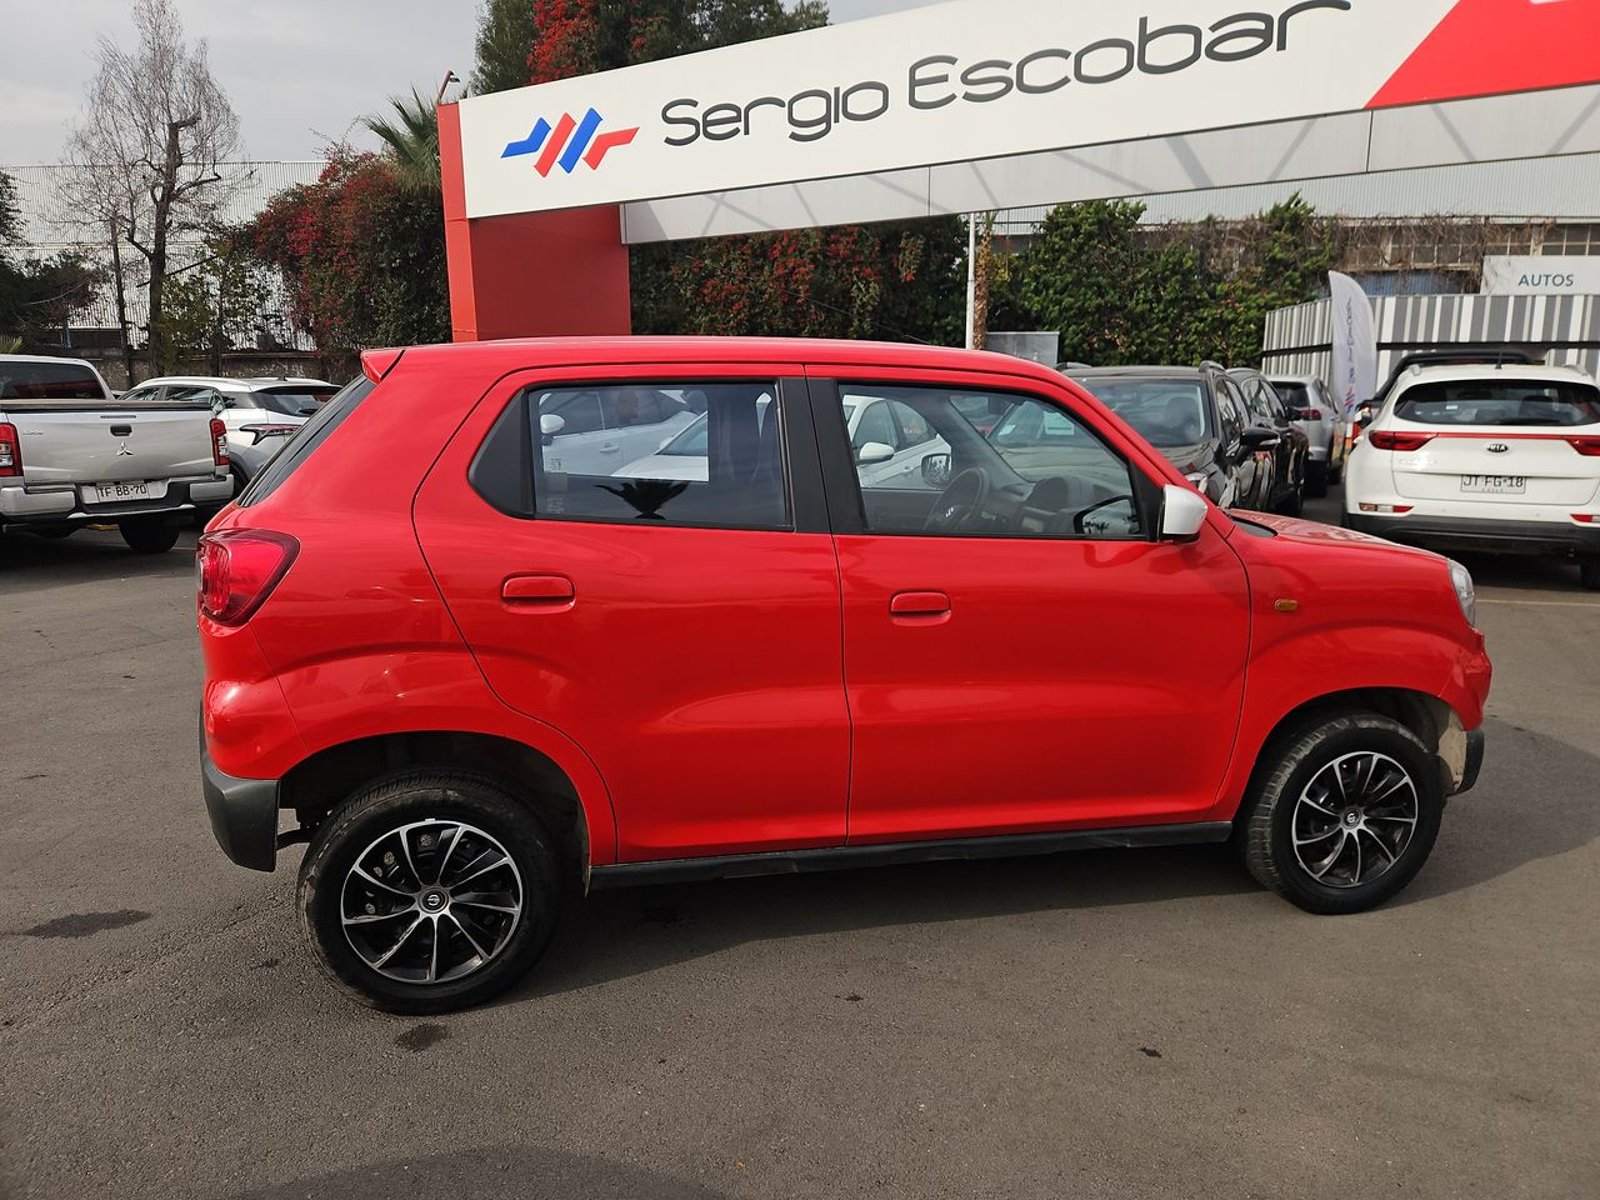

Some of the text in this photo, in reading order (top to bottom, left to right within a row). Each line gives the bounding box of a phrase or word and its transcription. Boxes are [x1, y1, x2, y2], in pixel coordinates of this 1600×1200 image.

[661, 0, 1351, 147] Sergio Escobar
[1518, 273, 1575, 288] AUTOS
